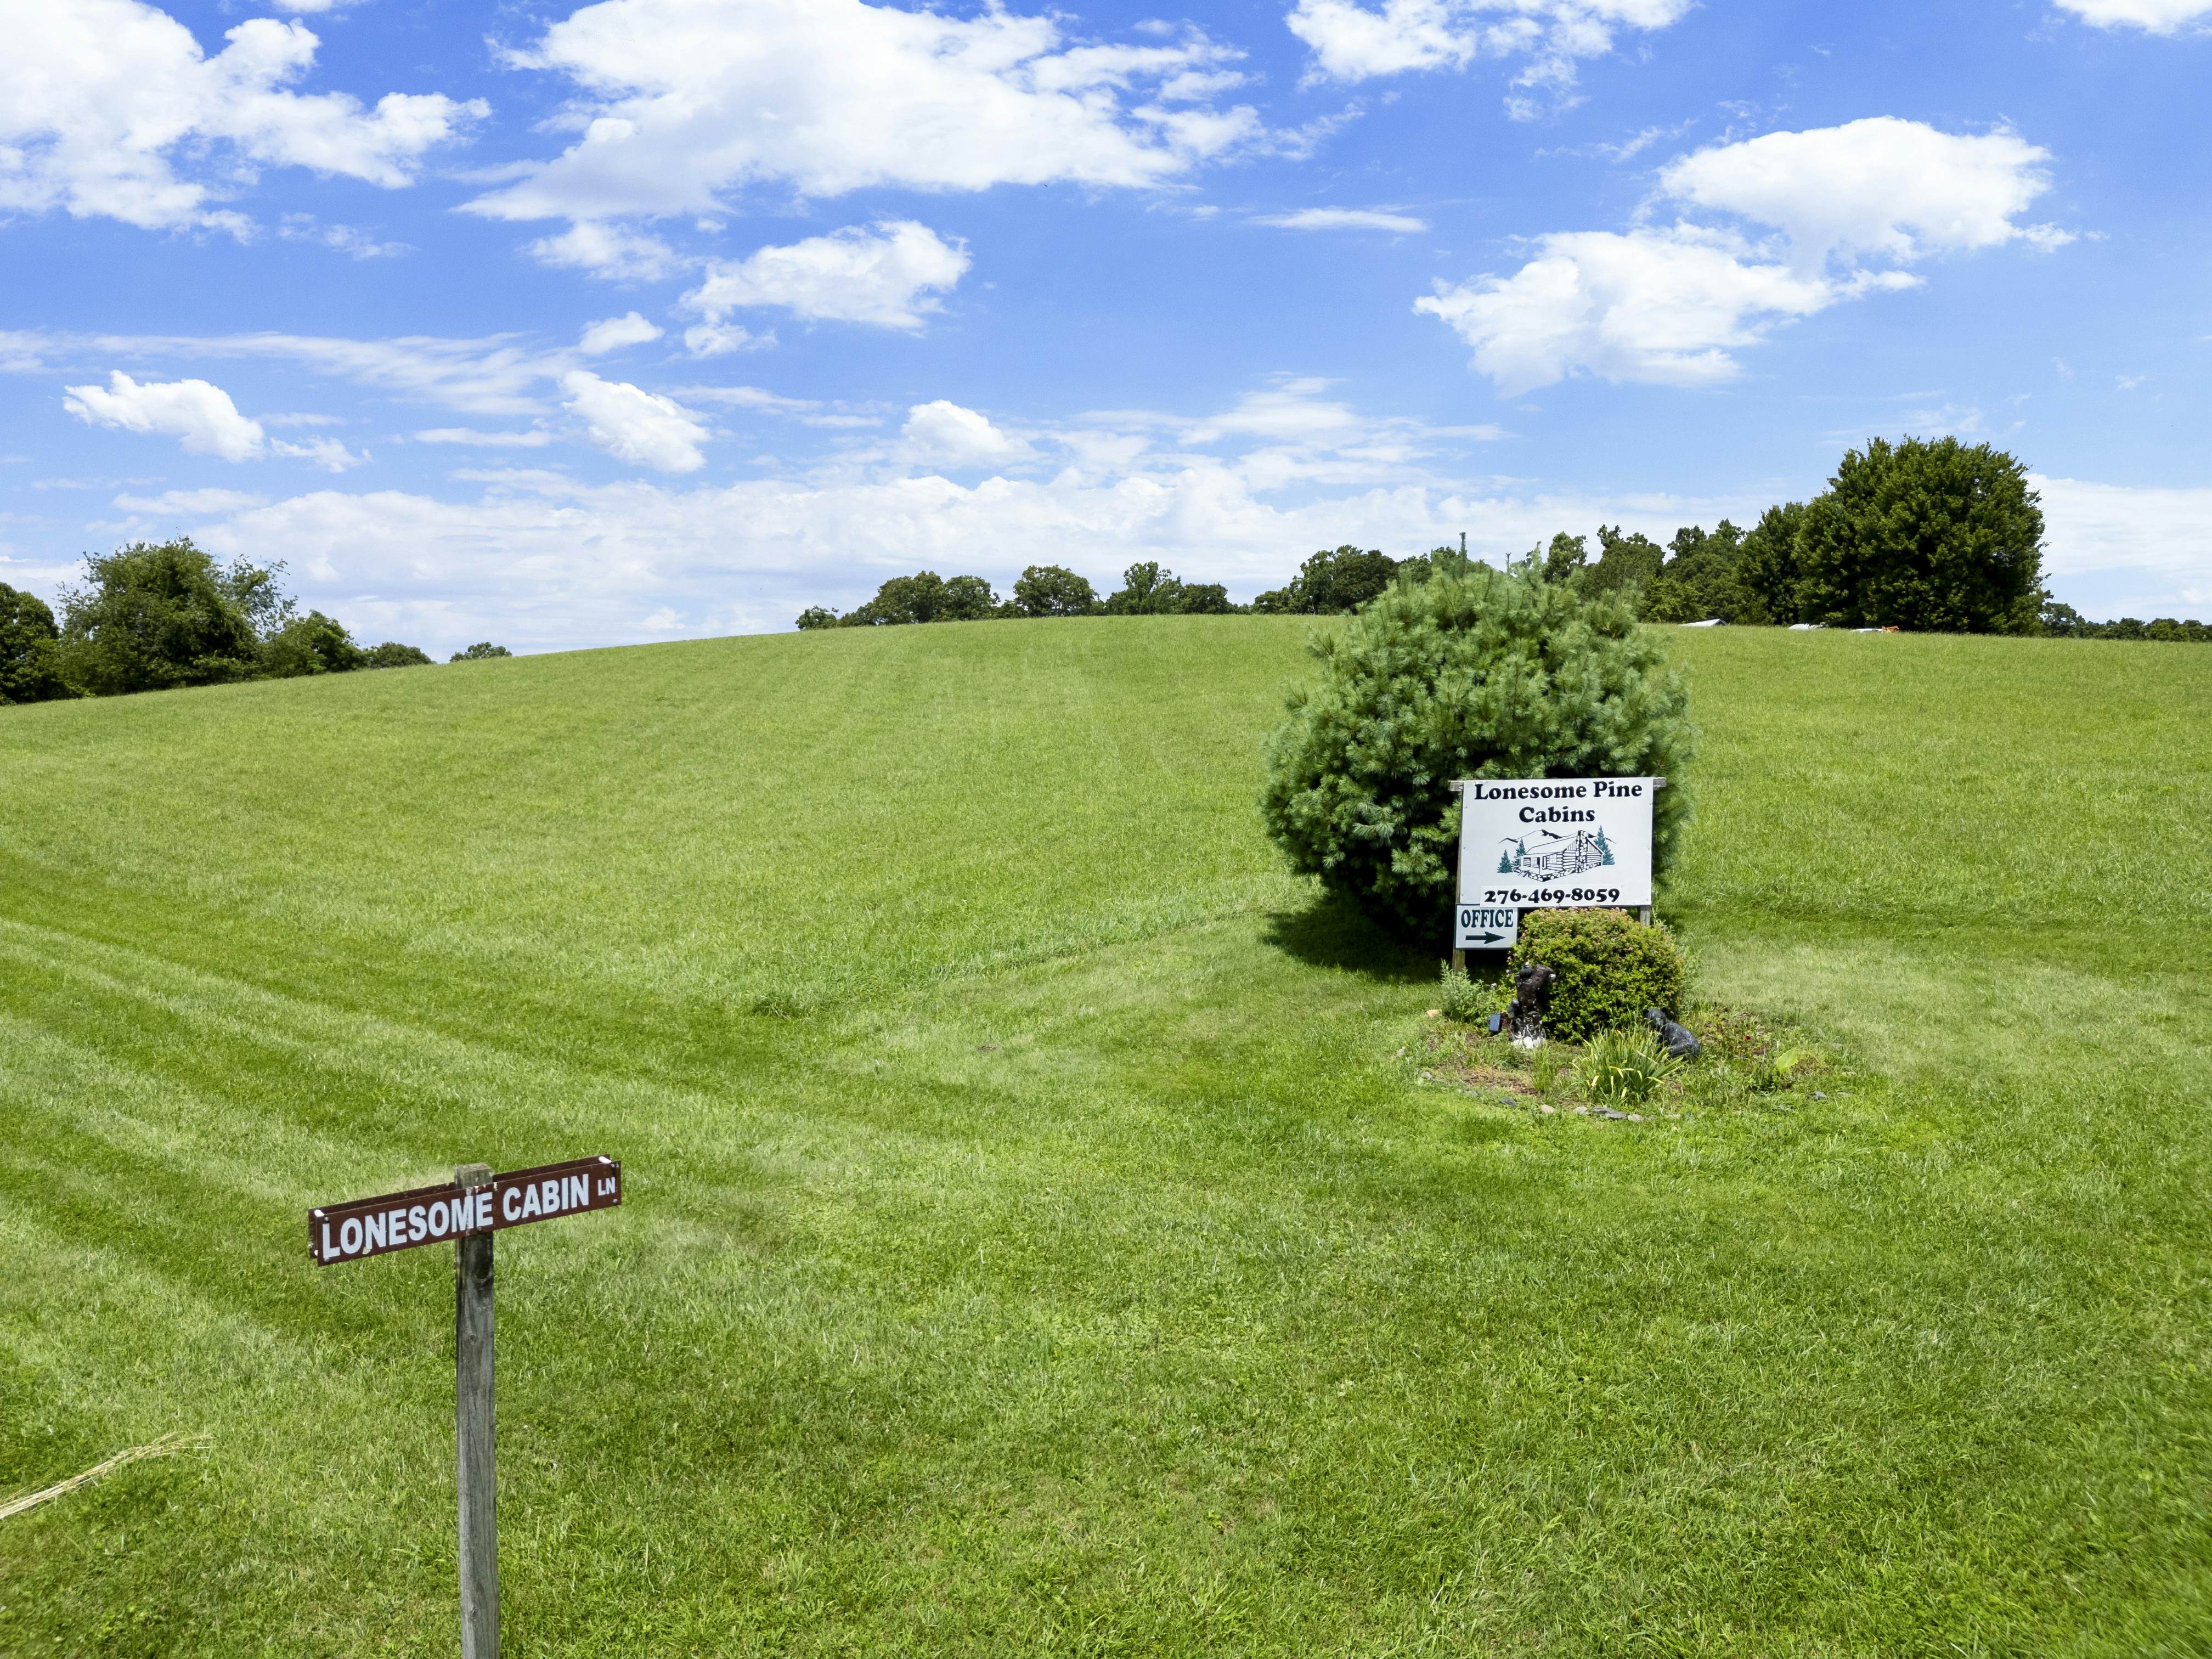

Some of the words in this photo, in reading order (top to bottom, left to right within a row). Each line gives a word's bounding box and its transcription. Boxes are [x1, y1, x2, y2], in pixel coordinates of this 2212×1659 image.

[1474, 783, 1587, 800] Lonesome
[1593, 781, 1642, 798] Pine
[1519, 806, 1595, 823] Cabins
[1484, 888, 1620, 905] 276-469-8059
[1460, 909, 1514, 928] OFFICE
[321, 1192, 494, 1261] LONESOME
[503, 1173, 589, 1221] CABIN
[597, 1176, 616, 1196] LN
